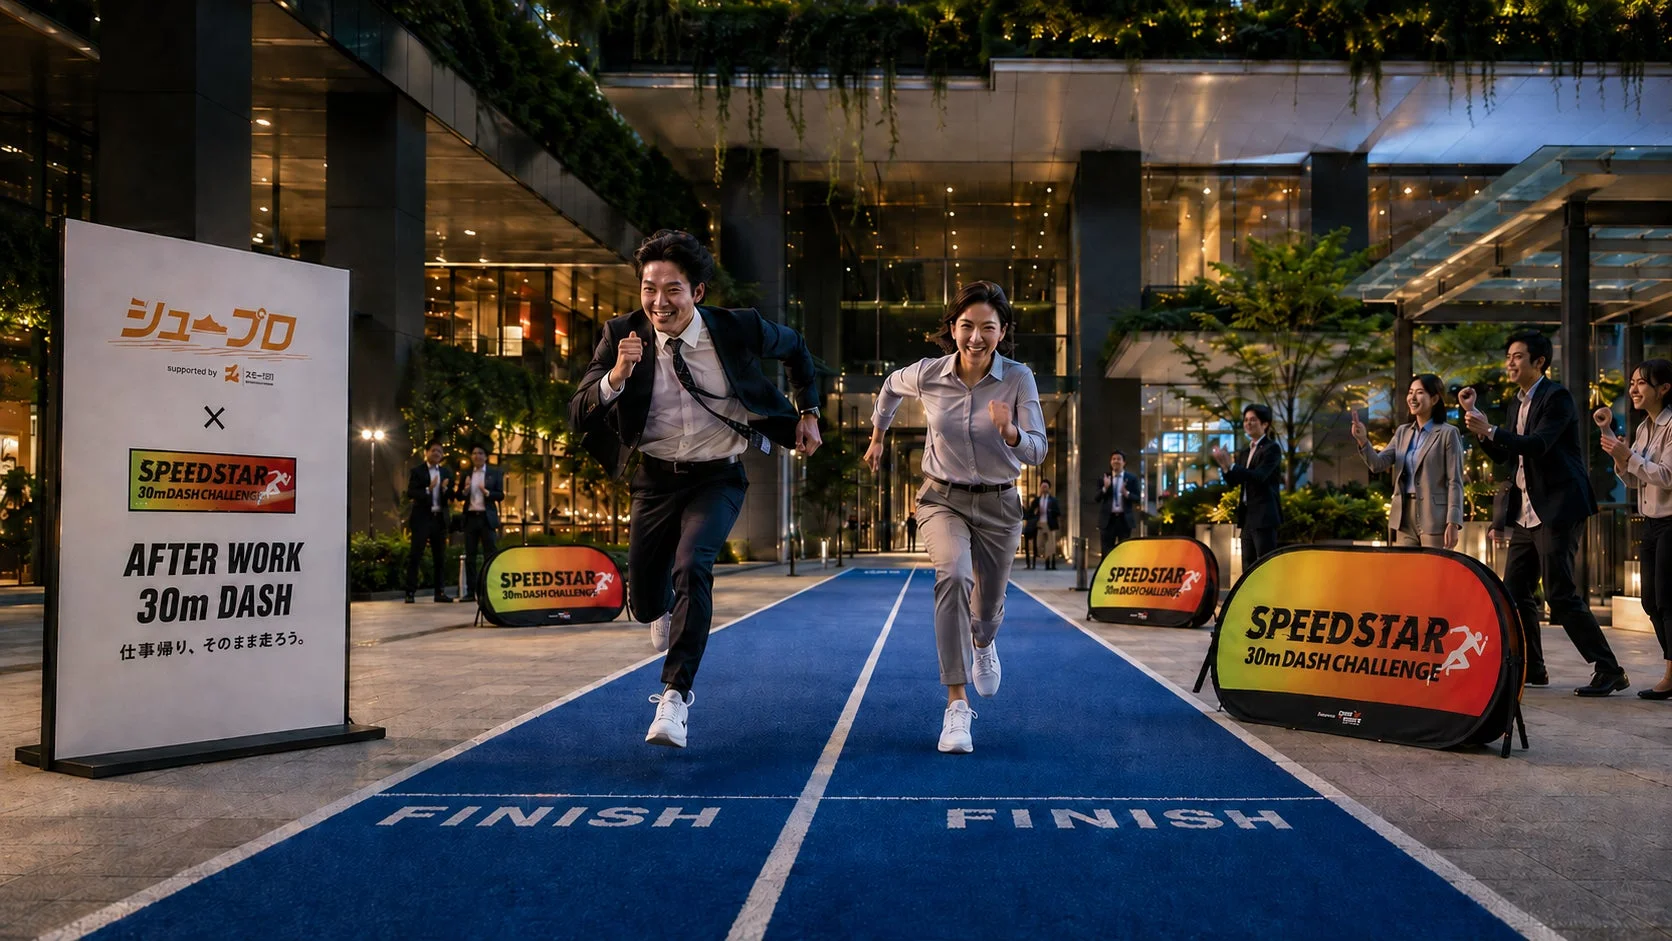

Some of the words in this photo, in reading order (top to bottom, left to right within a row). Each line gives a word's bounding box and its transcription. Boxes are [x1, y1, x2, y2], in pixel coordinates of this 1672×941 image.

[167, 365, 206, 376] supported
[208, 368, 217, 378] by
[138, 459, 268, 486] SPEEDSTAR
[123, 543, 218, 577] AFTER
[227, 542, 304, 574] WORK
[500, 571, 596, 588] SPEEDSTAR
[1107, 567, 1186, 584] SPEEDSTAR
[136, 587, 209, 624] 30m
[217, 583, 293, 619] DASH
[1245, 605, 1449, 654] SPEEDSTAR
[375, 806, 721, 828] FINISH
[947, 808, 1293, 830] FINISH
